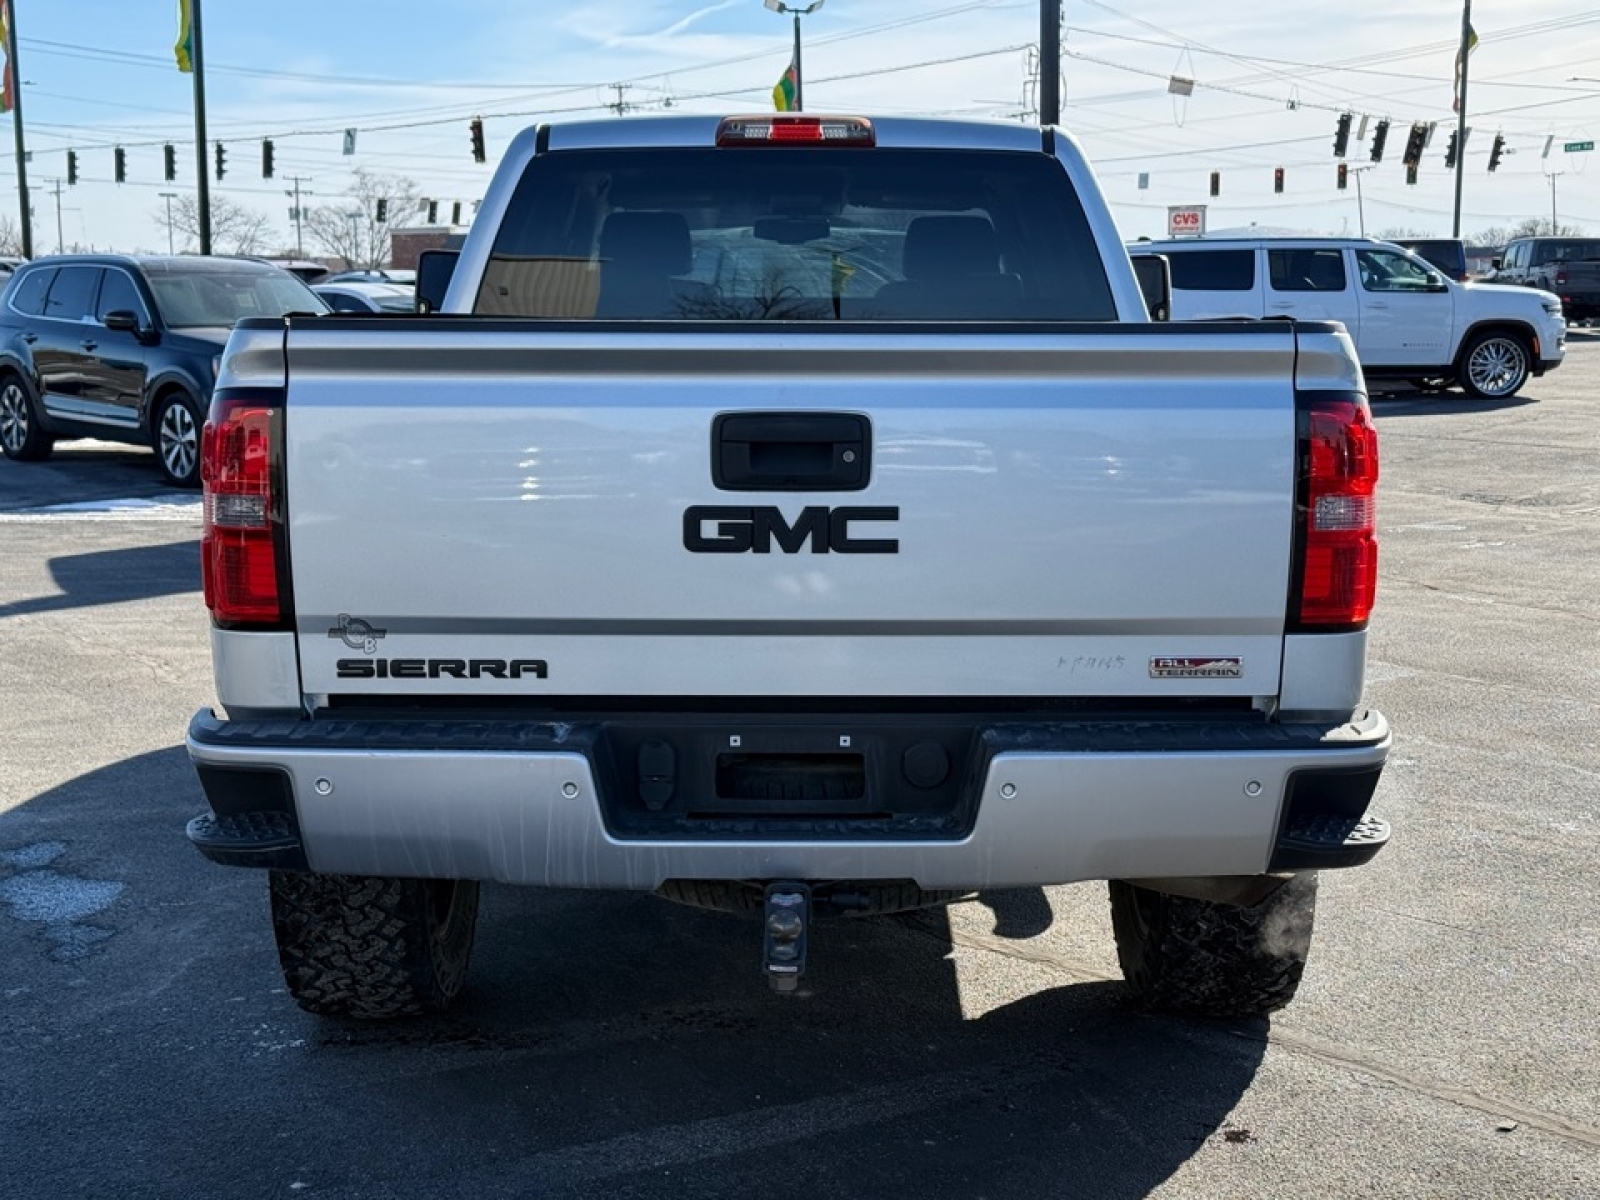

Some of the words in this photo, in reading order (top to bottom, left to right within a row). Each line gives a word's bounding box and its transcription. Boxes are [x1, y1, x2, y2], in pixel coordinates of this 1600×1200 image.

[1173, 212, 1199, 225] CVS
[683, 505, 899, 553] GMC
[363, 638, 377, 655] B
[336, 659, 548, 678] SIERRA
[1159, 659, 1196, 668] ALL
